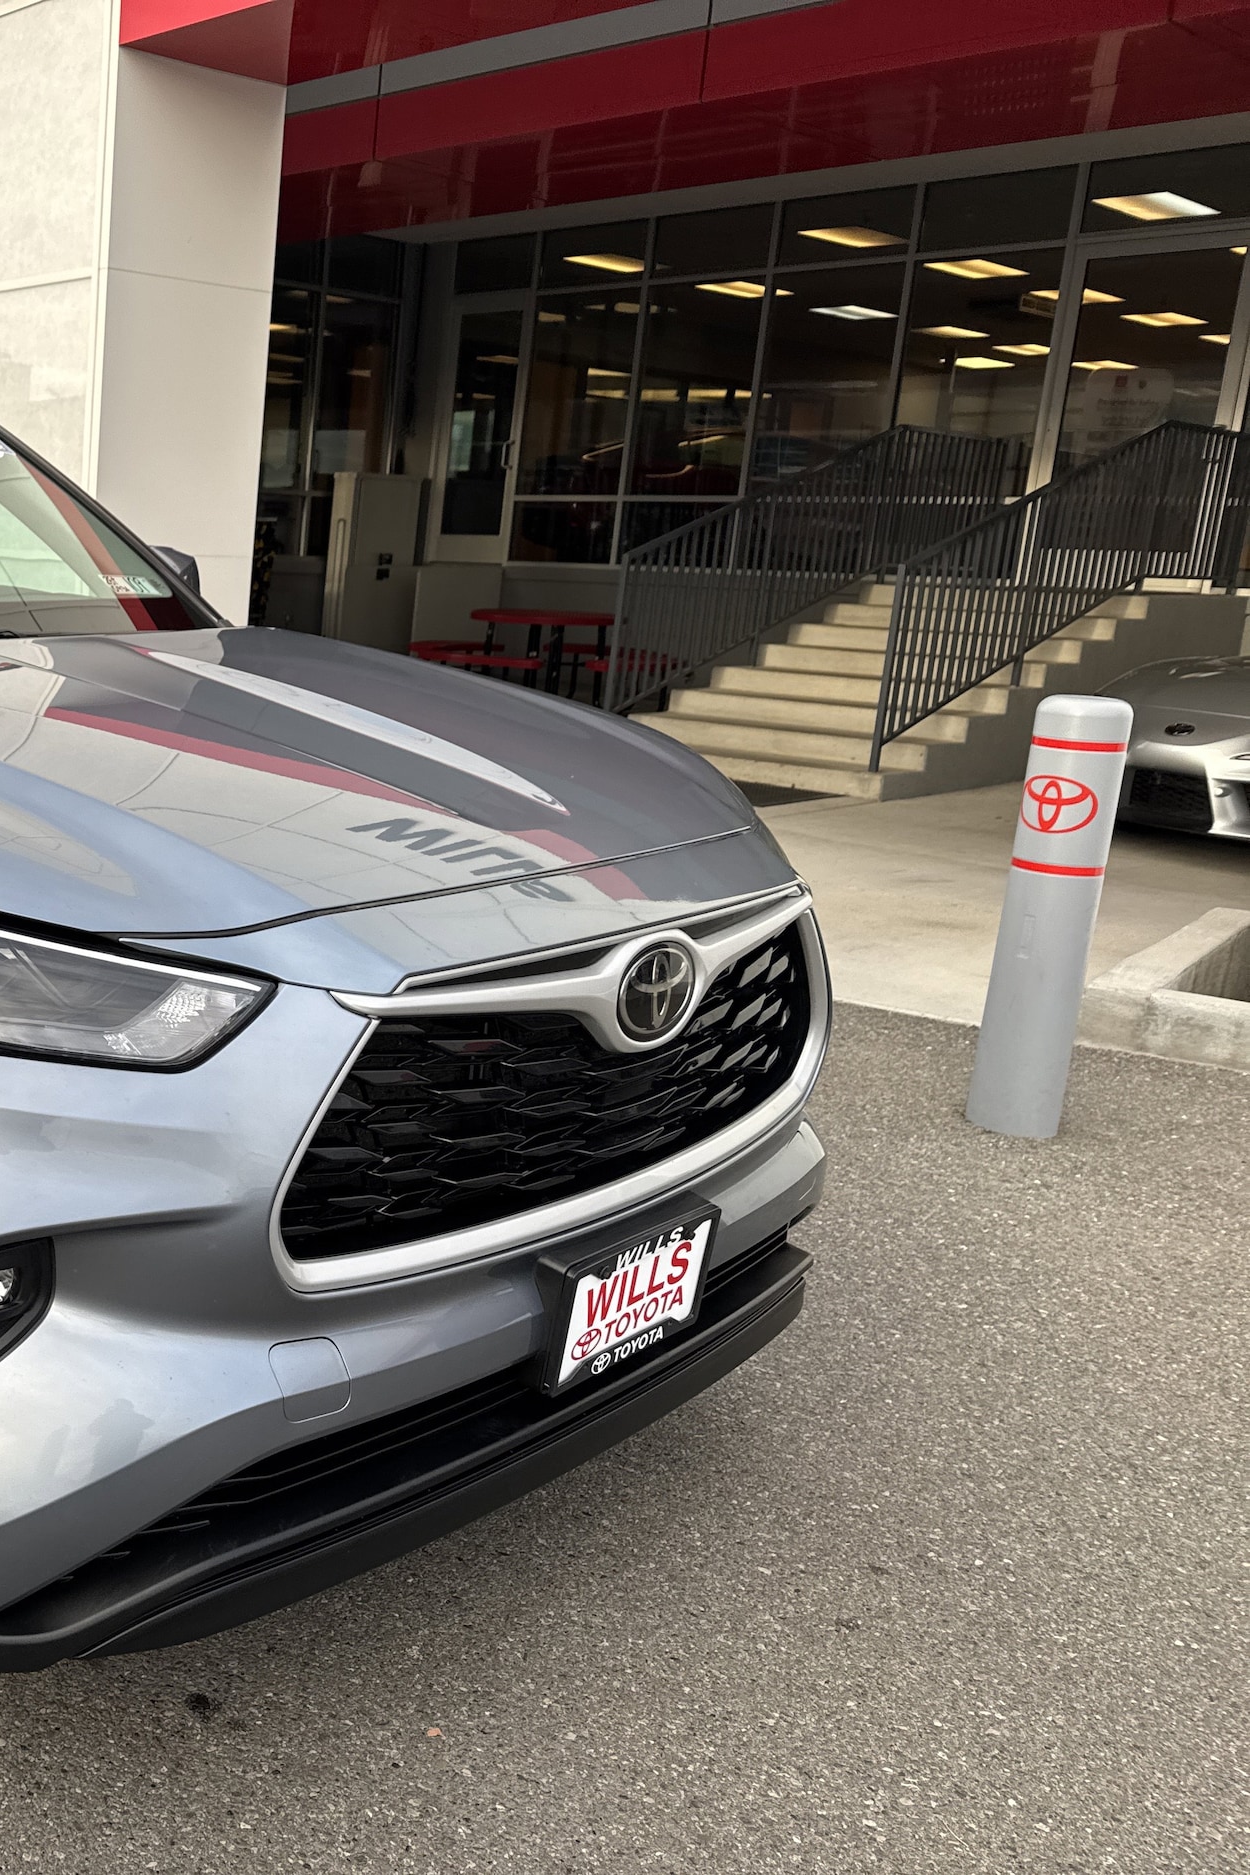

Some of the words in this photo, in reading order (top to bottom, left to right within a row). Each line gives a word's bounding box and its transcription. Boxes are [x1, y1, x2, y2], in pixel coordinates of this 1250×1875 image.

[615, 1225, 685, 1272] WILLS
[587, 1241, 692, 1329] WILLS
[604, 1285, 683, 1345] TOYOTA
[613, 1325, 664, 1363] TOYOTA
